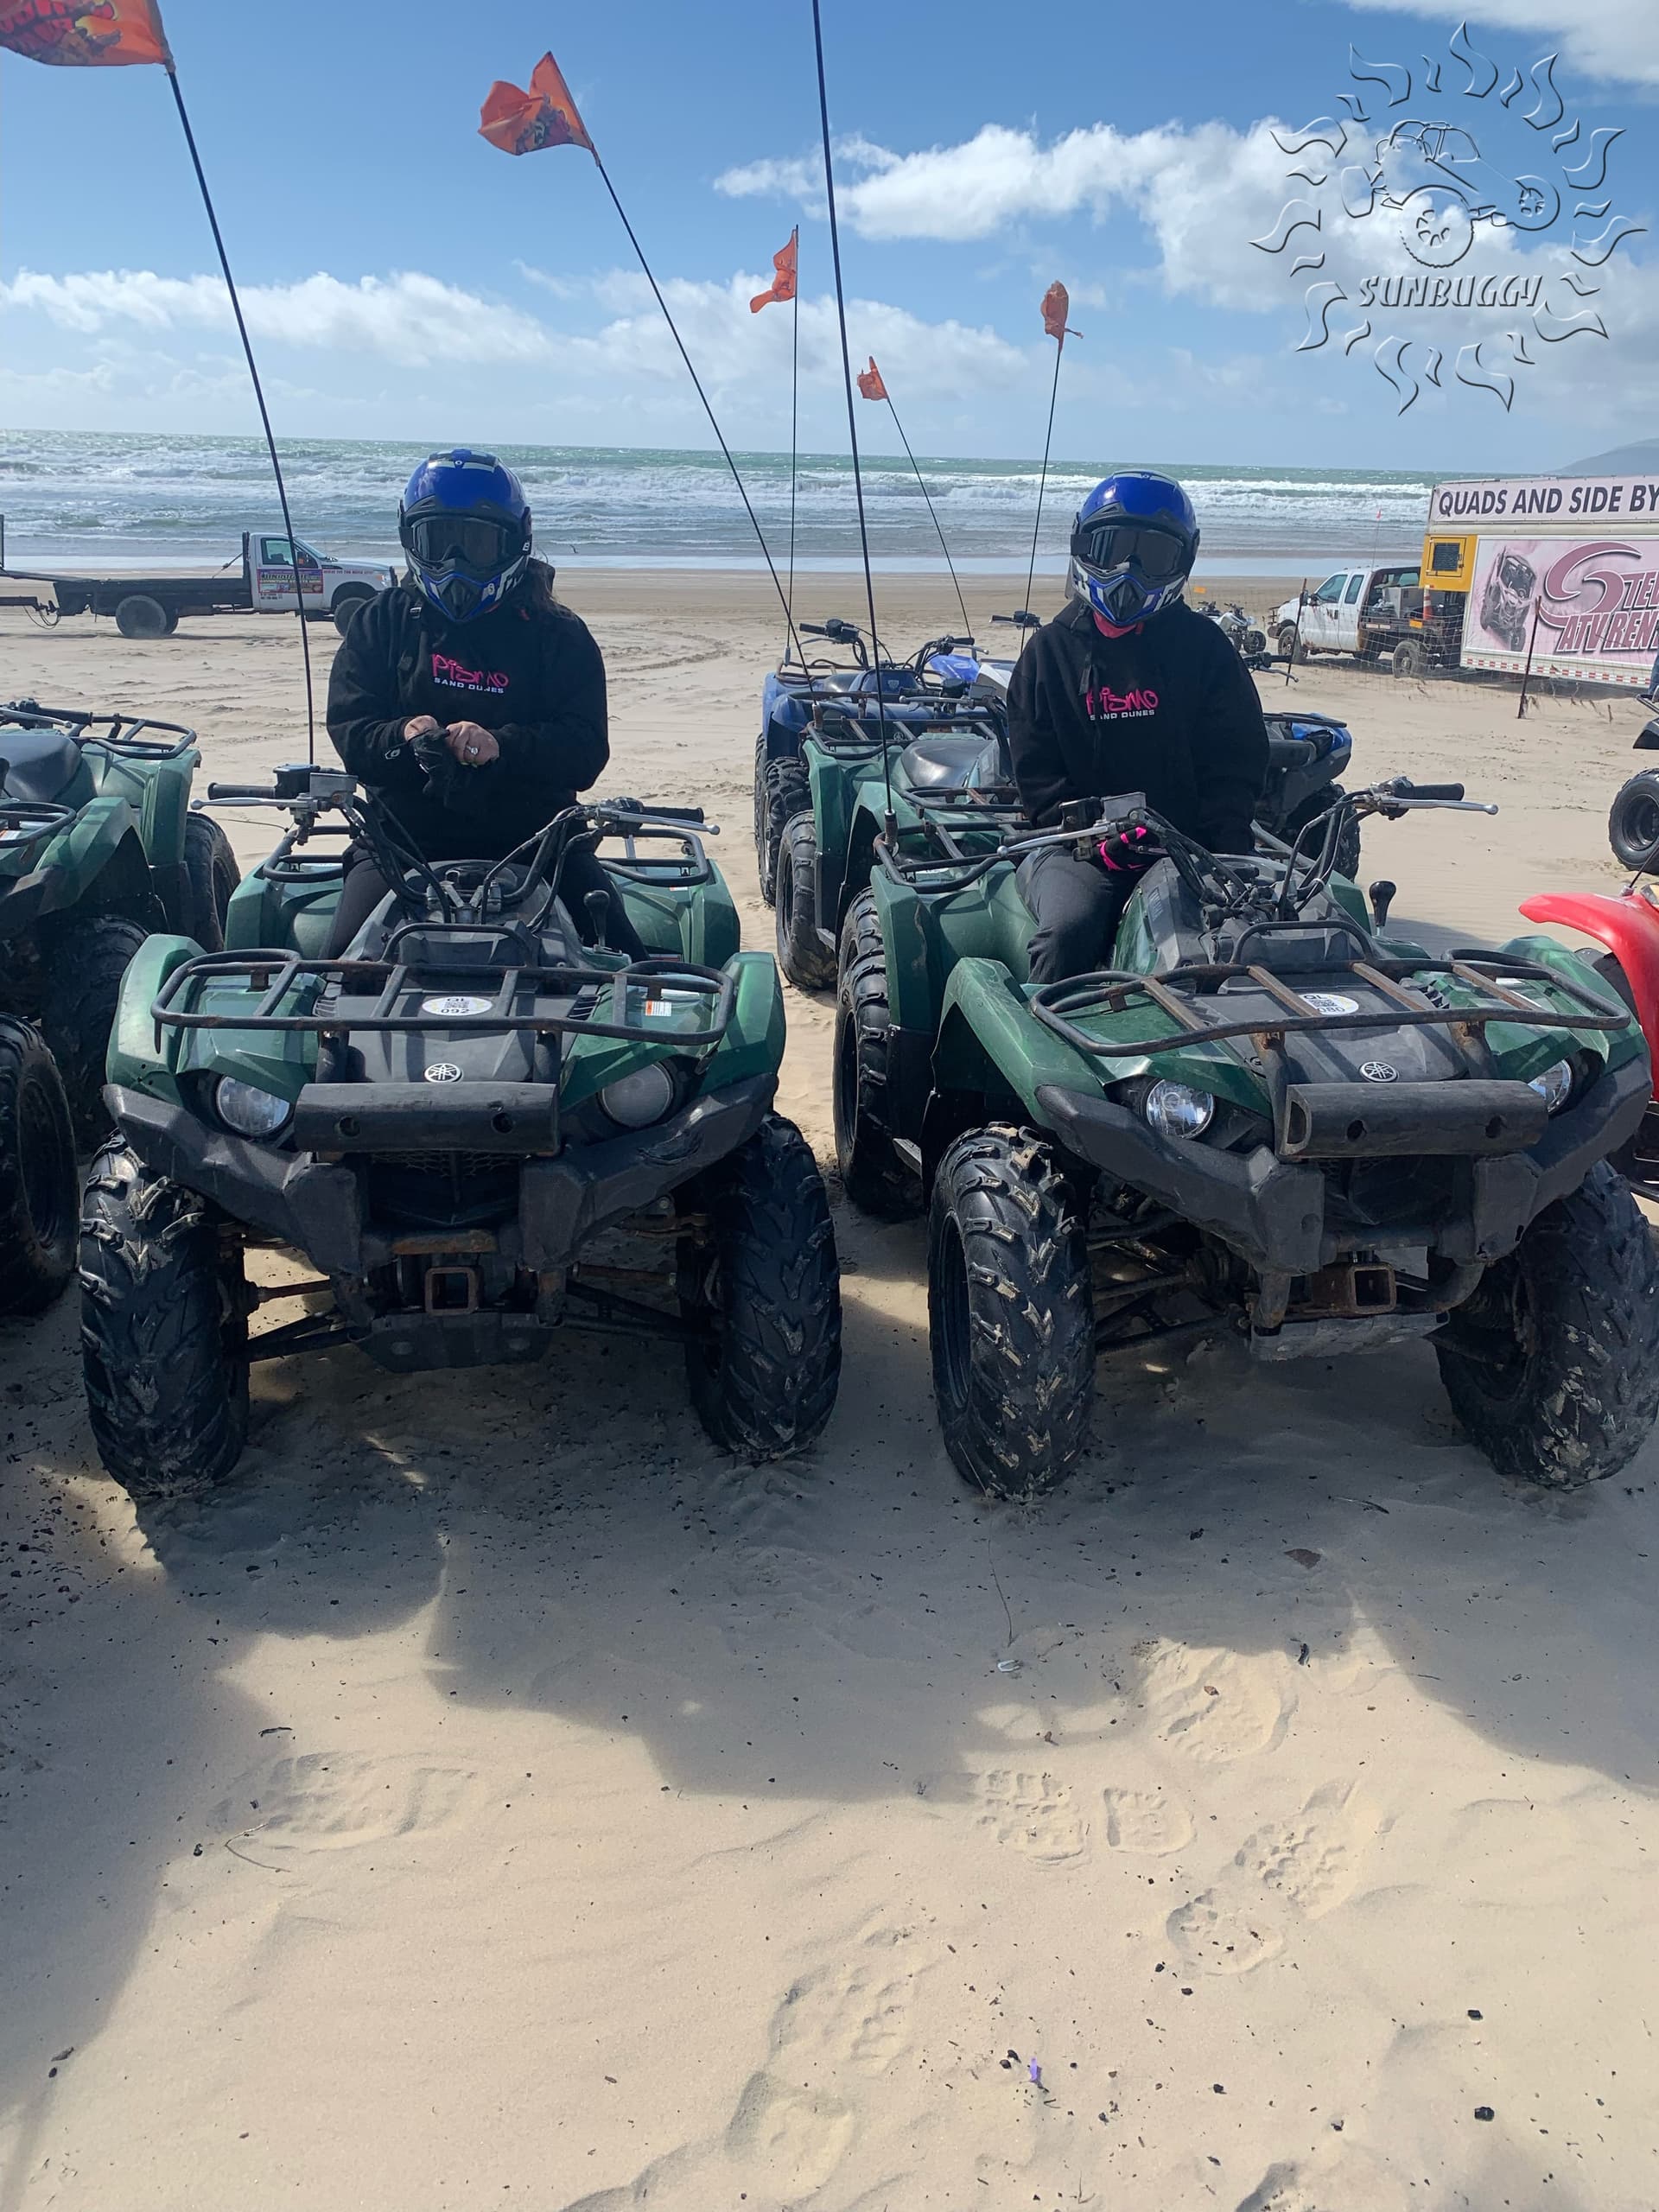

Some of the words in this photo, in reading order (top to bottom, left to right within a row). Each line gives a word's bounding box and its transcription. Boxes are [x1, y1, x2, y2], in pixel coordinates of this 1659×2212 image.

[1439, 489, 1508, 517] QUADS
[1512, 487, 1562, 514] AND
[1569, 486, 1623, 513] SIDE
[1630, 484, 1659, 512] BY
[1556, 612, 1611, 652] ATV
[1602, 609, 1659, 652] REN
[434, 677, 465, 688] SAND
[1121, 709, 1155, 719] DUNES
